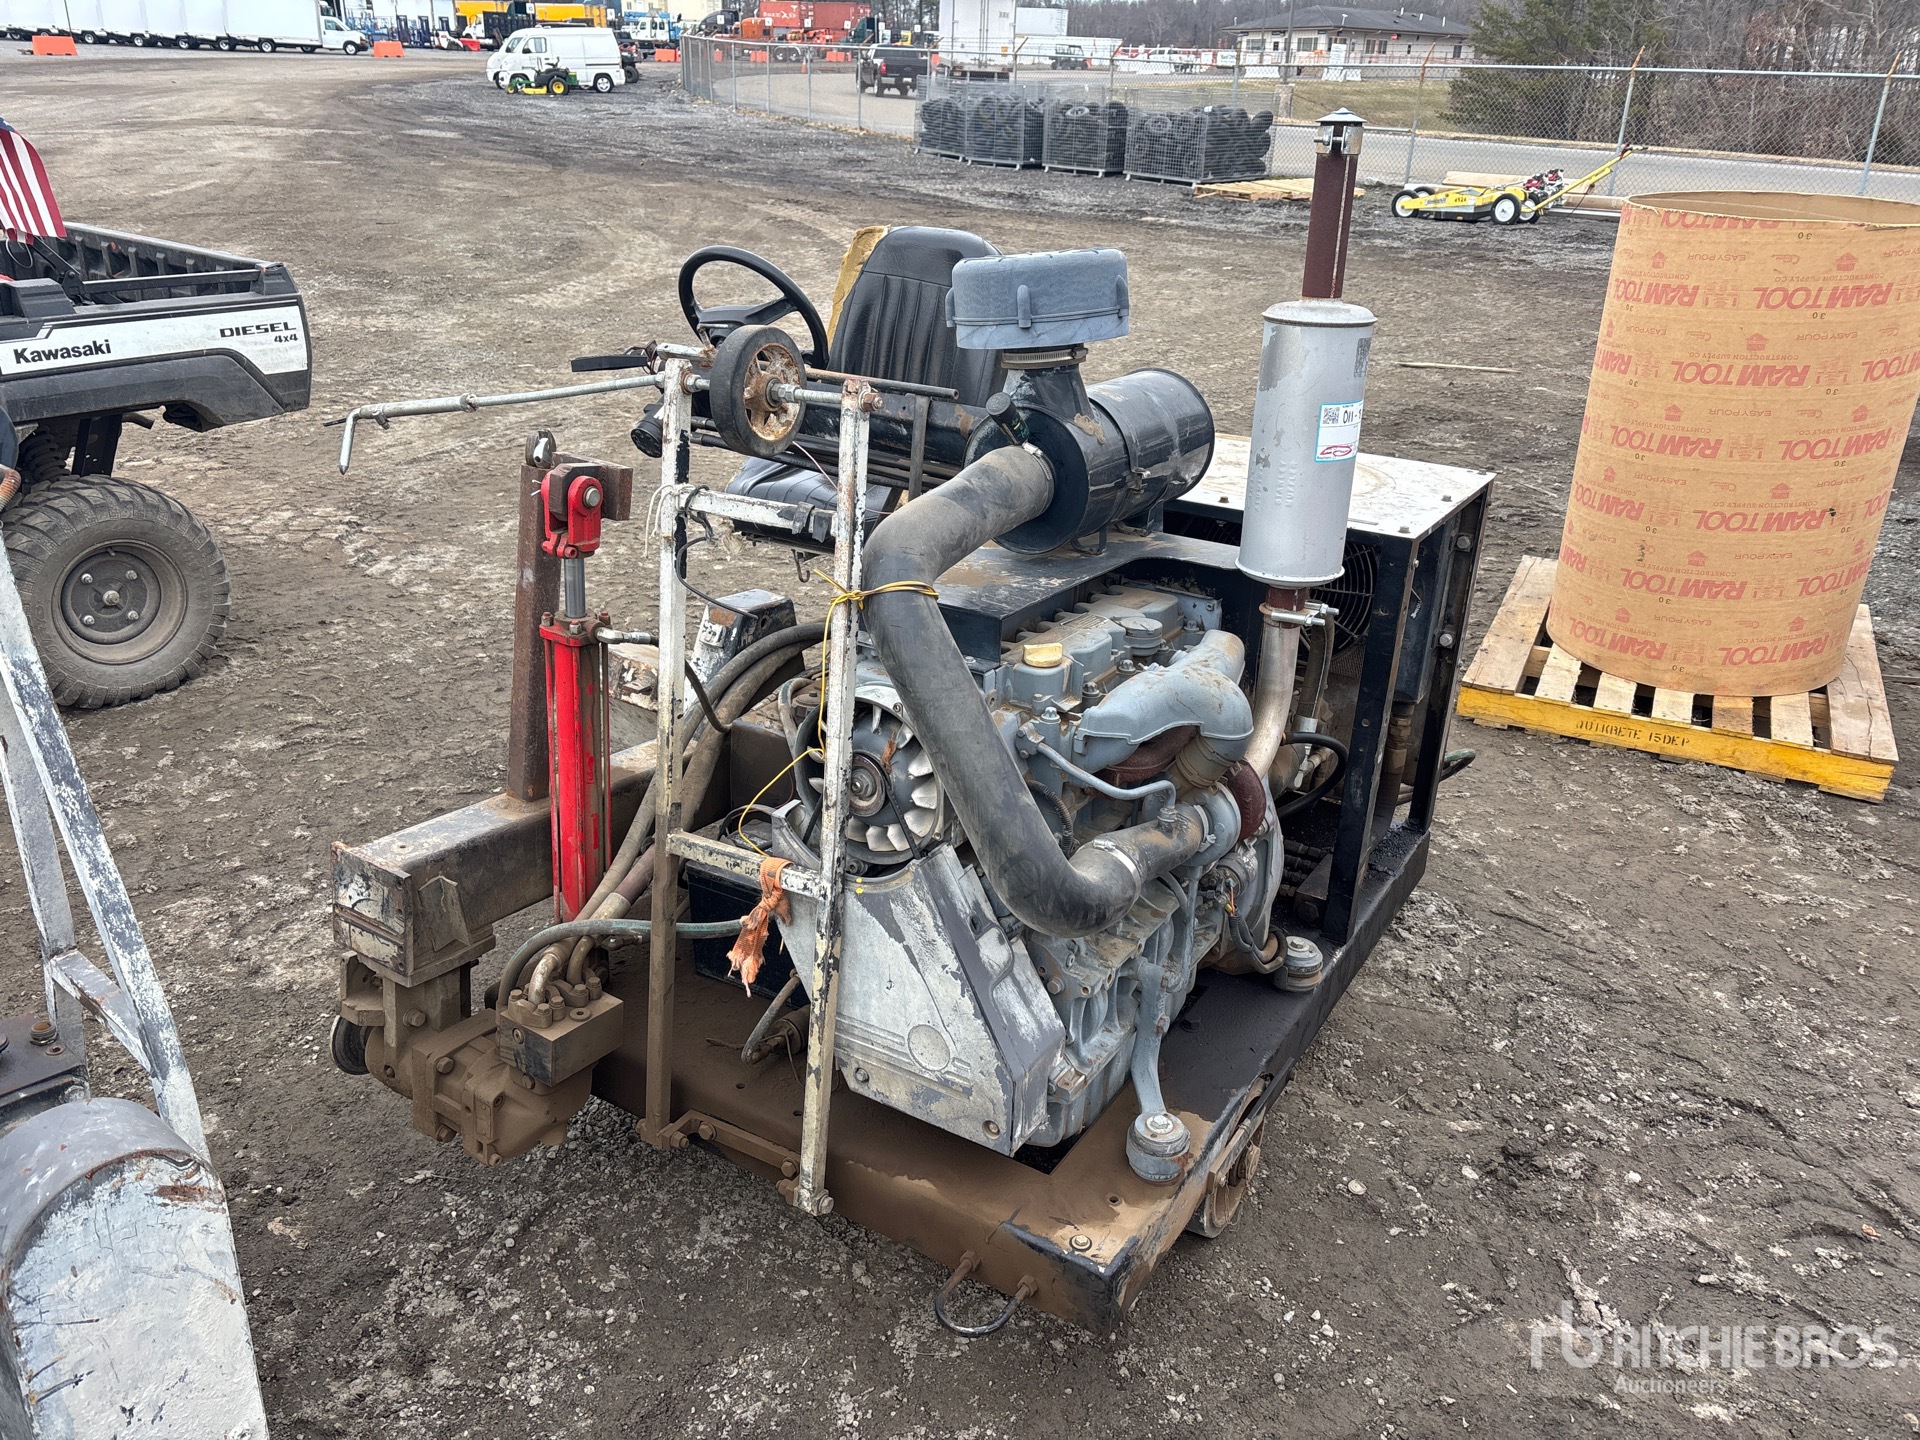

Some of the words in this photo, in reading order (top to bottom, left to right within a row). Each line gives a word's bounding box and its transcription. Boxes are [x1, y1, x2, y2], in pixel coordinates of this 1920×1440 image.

[1812, 311, 1826, 320] 30
[219, 321, 297, 338] DIESEL
[274, 333, 299, 344] 4x4
[13, 339, 112, 364] Kawasaki
[1733, 353, 1799, 361] CONSTRUCTION
[1826, 388, 1838, 396] 30
[1708, 408, 1772, 417] EASYPOUR
[1635, 453, 1645, 461] 30
[1645, 525, 1657, 534] 30
[1734, 552, 1793, 560] EASYPOUR
[1659, 596, 1671, 605] 30
[1654, 615, 1712, 626] EASYPOUR
